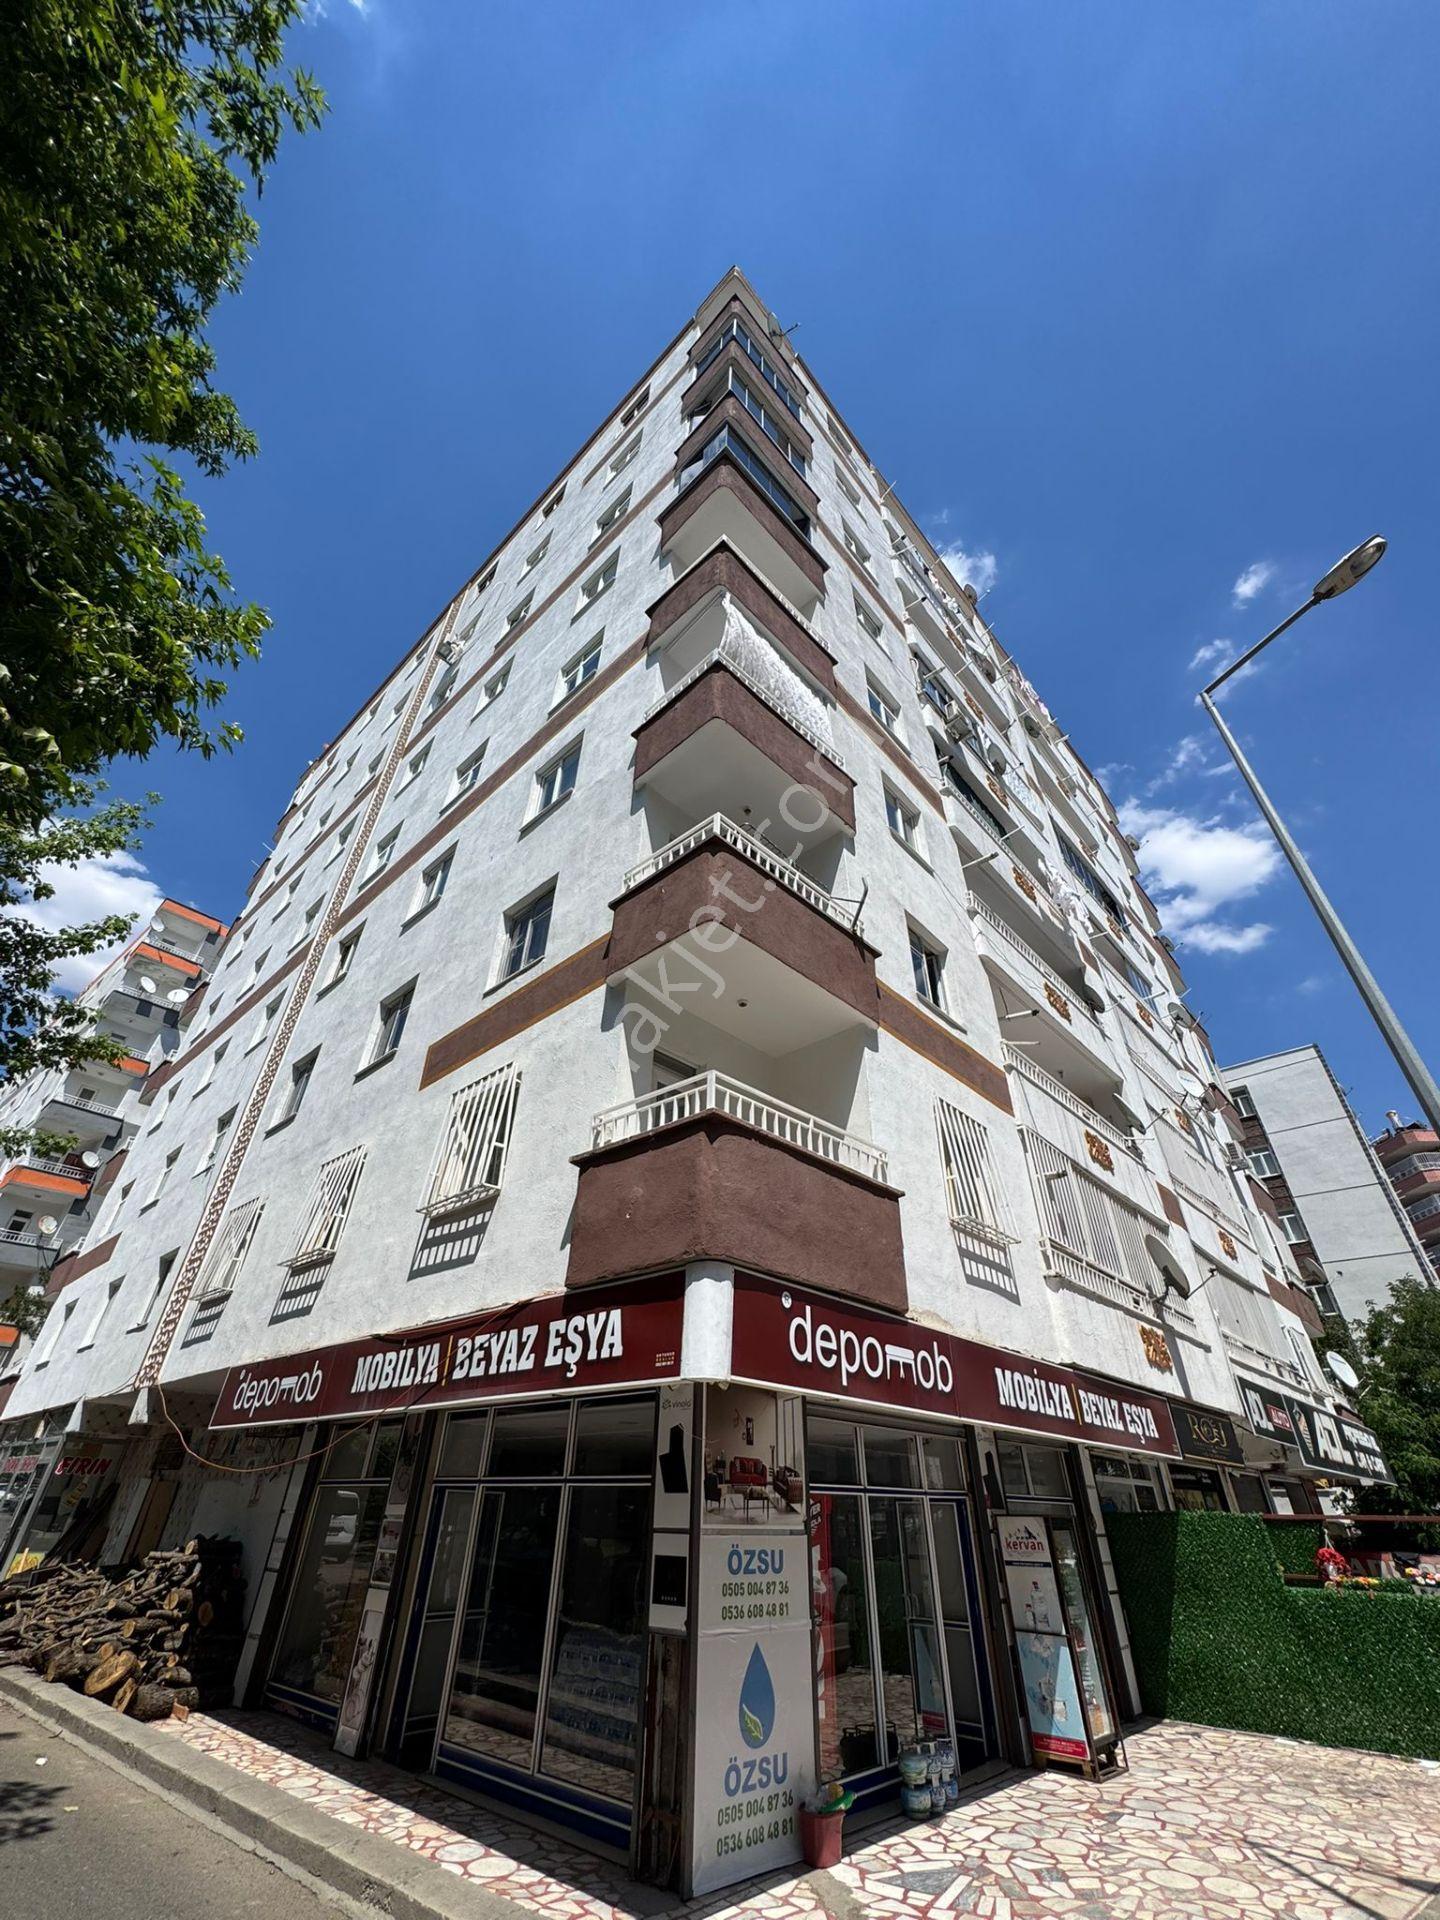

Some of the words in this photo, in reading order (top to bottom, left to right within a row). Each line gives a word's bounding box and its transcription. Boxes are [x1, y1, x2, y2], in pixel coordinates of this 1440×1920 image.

[350, 1337, 443, 1395] MOBİLYA
[452, 1325, 538, 1382] BEYAZ
[545, 1308, 624, 1378] EŞYA
[789, 1305, 953, 1394] depomob
[233, 1359, 323, 1418] depomob
[994, 1367, 1075, 1420] MOBİLYA
[1078, 1389, 1123, 1431] BEYAZ
[1124, 1401, 1160, 1445] EŞYA
[55, 1456, 112, 1475] FIRIN
[727, 1544, 784, 1575] ÖZSU
[1005, 1537, 1044, 1551] kervan
[721, 1581, 745, 1597] 0505
[747, 1581, 764, 1596] 004
[765, 1581, 777, 1595] 87
[778, 1580, 790, 1594] 36
[721, 1605, 745, 1620] 0536
[747, 1604, 764, 1619] 608
[765, 1603, 777, 1618] 48
[778, 1603, 790, 1617] 81
[724, 1752, 788, 1797] ÖZSU
[717, 1802, 744, 1827] 0505
[746, 1796, 765, 1820] 004
[767, 1793, 780, 1812] 87
[781, 1789, 794, 1808] 36
[716, 1832, 743, 1857] 0536
[745, 1825, 765, 1847] 608
[767, 1820, 780, 1840] 48
[781, 1816, 794, 1835] 81
